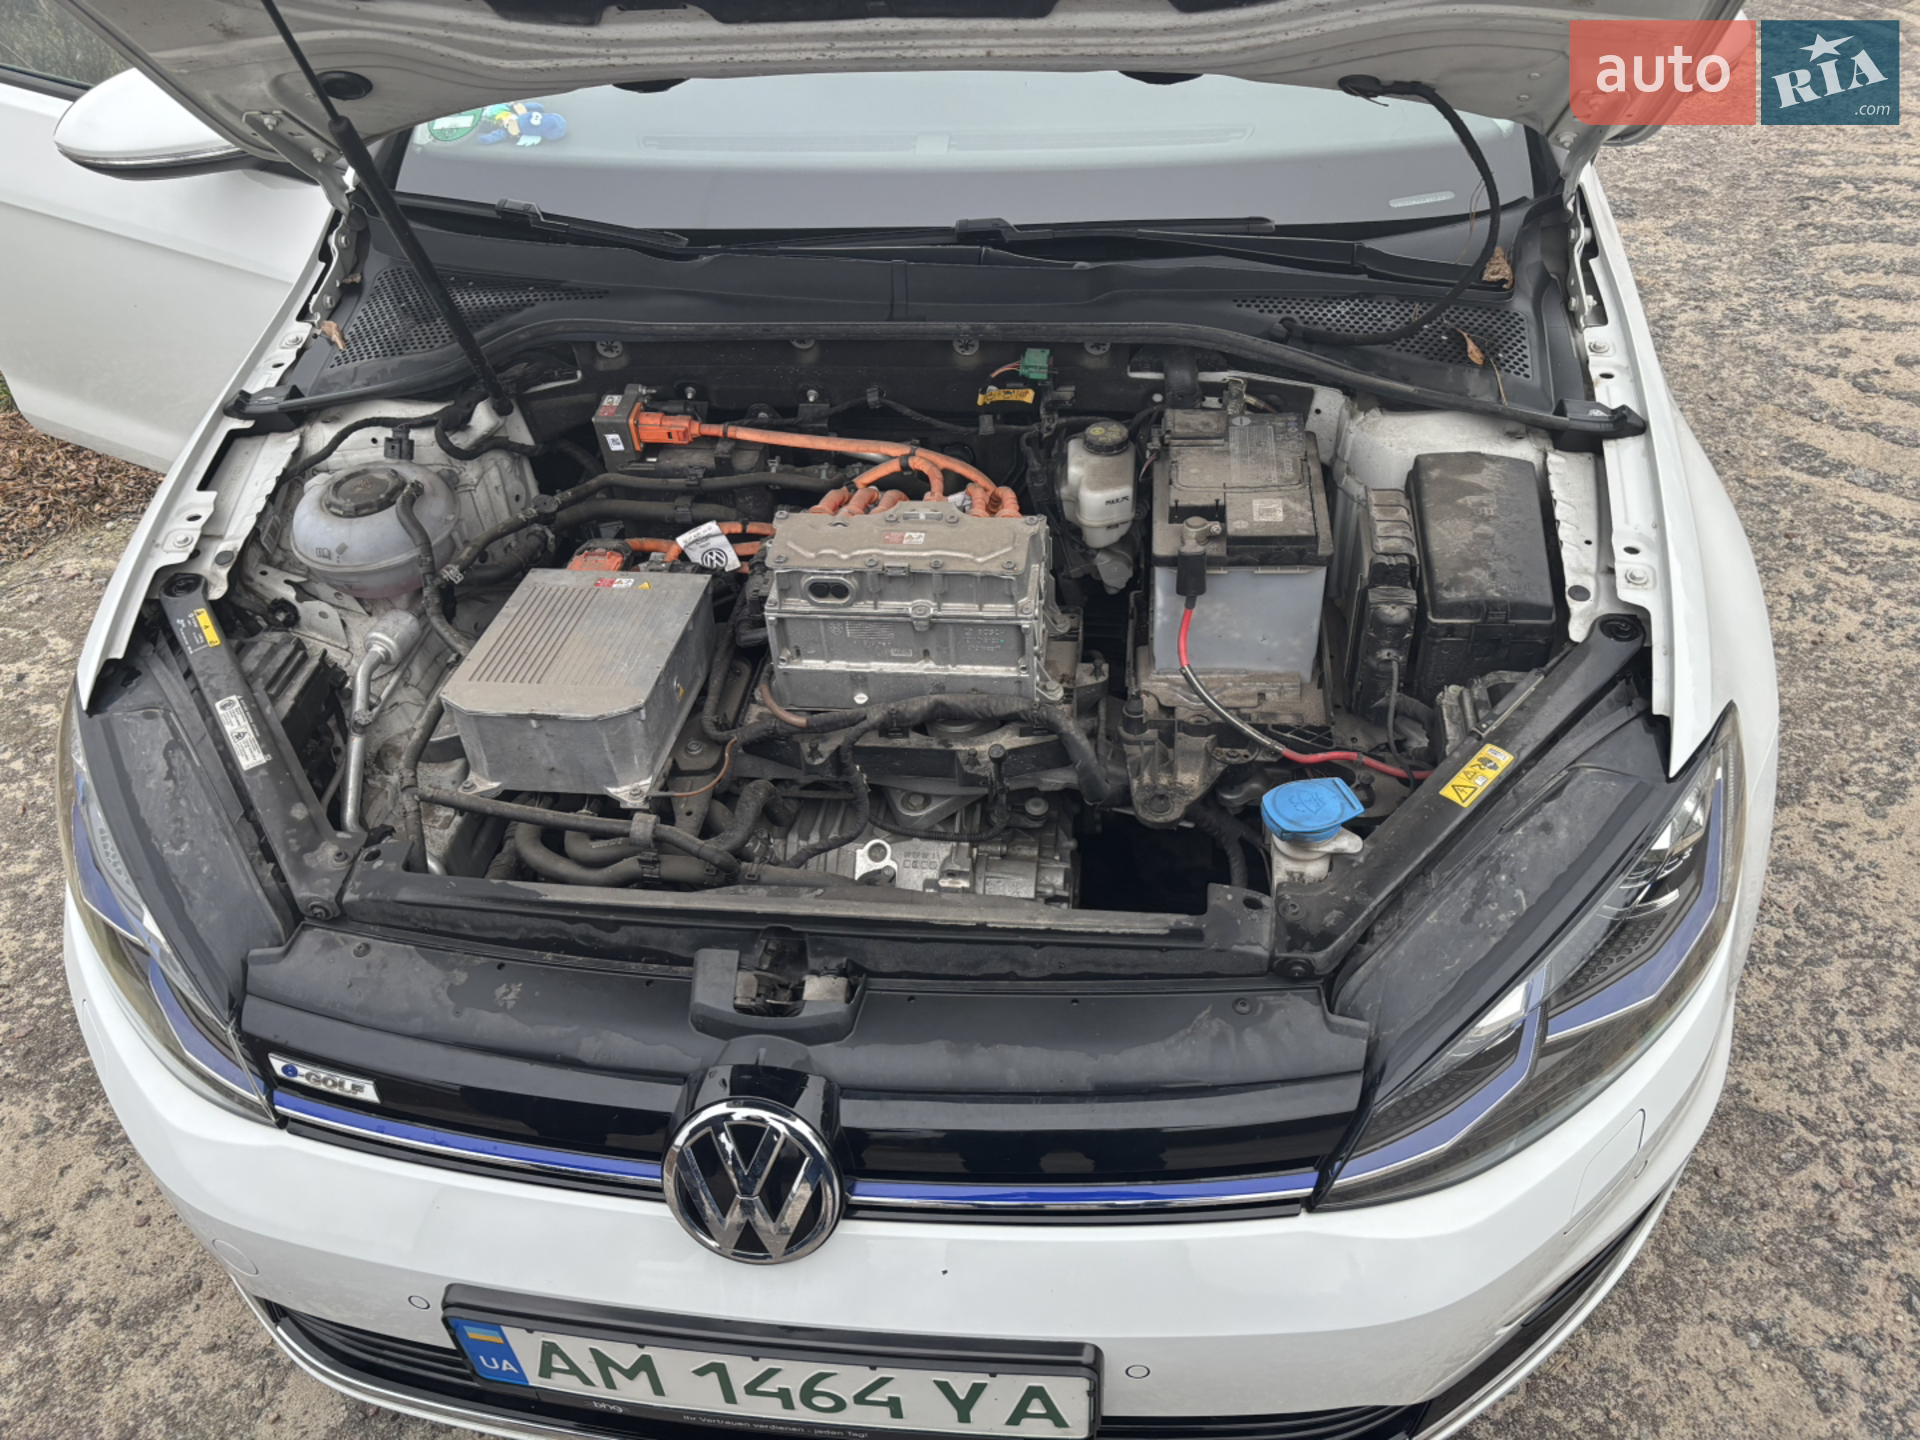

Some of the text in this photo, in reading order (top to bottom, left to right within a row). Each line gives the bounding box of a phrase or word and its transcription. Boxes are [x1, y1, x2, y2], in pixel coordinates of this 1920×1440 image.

[479, 1355, 519, 1376] UA
[537, 1340, 1070, 1429] AM 1464 YA
[700, 1416, 750, 1428] Vertrauen
[752, 1422, 805, 1433] verdienen
[813, 1429, 844, 1437] jeden
